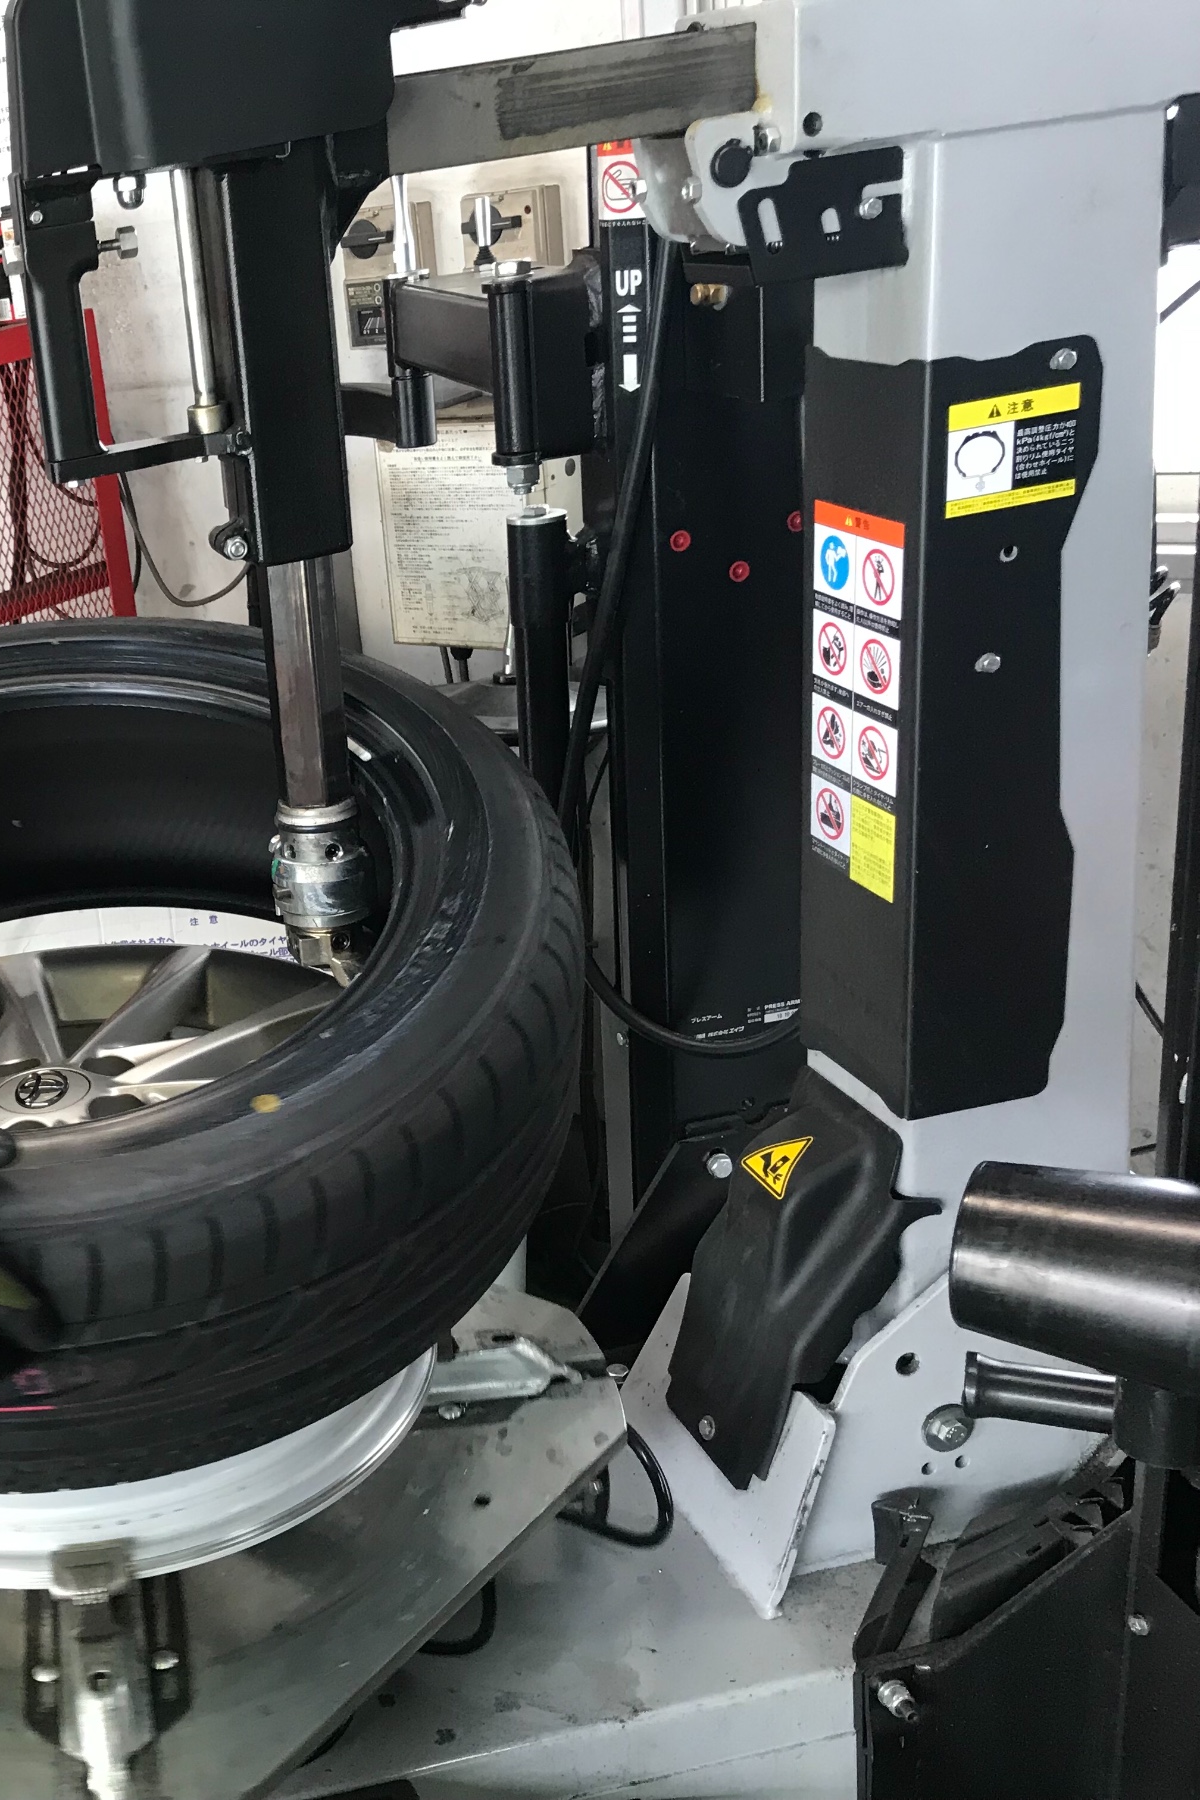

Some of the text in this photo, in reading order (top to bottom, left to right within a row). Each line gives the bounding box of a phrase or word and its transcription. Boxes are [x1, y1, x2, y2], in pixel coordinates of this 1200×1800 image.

[615, 269, 642, 296] UP
[1006, 398, 1035, 415] 注意
[764, 1002, 785, 1010] PRESS
[691, 1013, 723, 1024] プレスアーム
